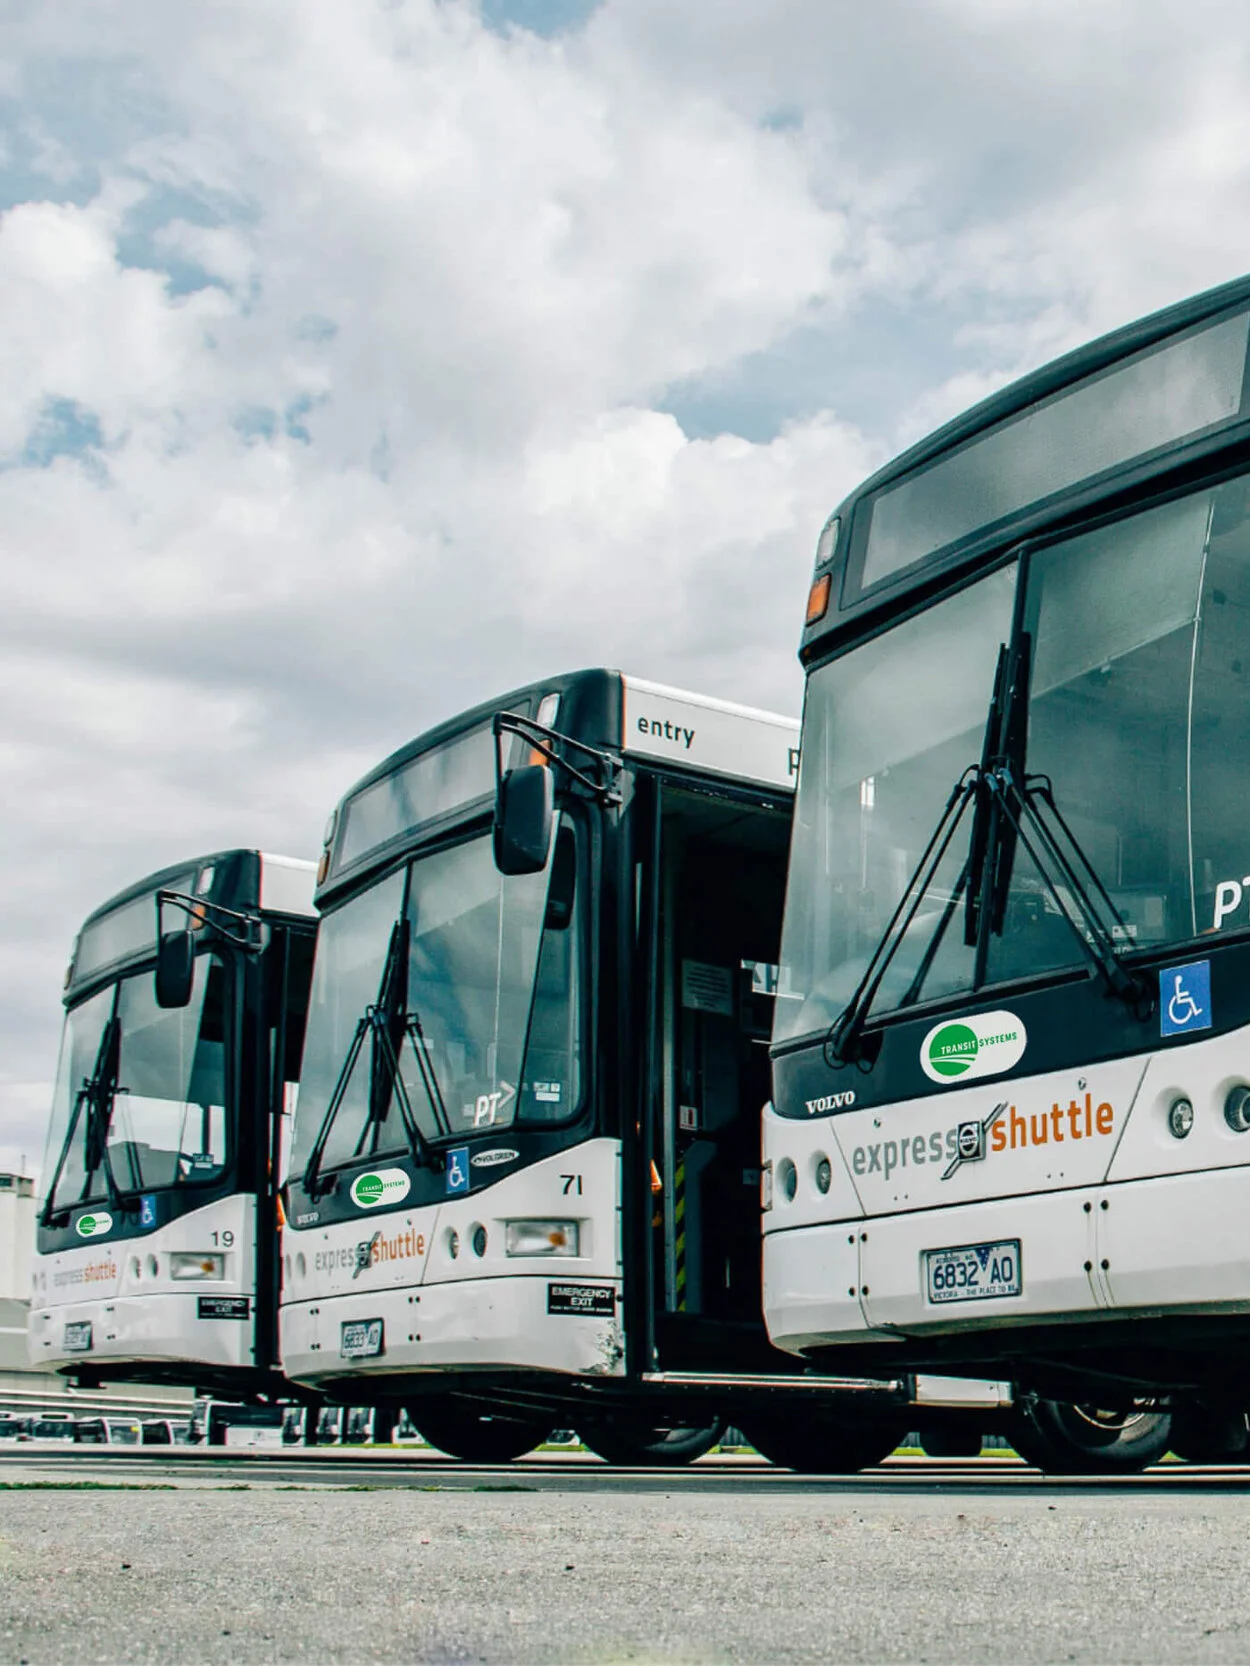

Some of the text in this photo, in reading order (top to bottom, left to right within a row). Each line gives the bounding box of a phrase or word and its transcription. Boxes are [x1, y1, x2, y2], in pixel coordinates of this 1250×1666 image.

[637, 717, 695, 749] entry
[941, 1031, 1018, 1055] TRANSIT SYSTEMS
[806, 1091, 855, 1115] VOLVO
[991, 1093, 1114, 1152] shuttle
[560, 1174, 583, 1196] 71
[211, 1231, 234, 1247] 19
[372, 1228, 424, 1263] shuttle
[933, 1256, 1013, 1290] 6832 AO
[551, 1286, 611, 1299] EMERGENCY
[571, 1297, 592, 1307] EXIT
